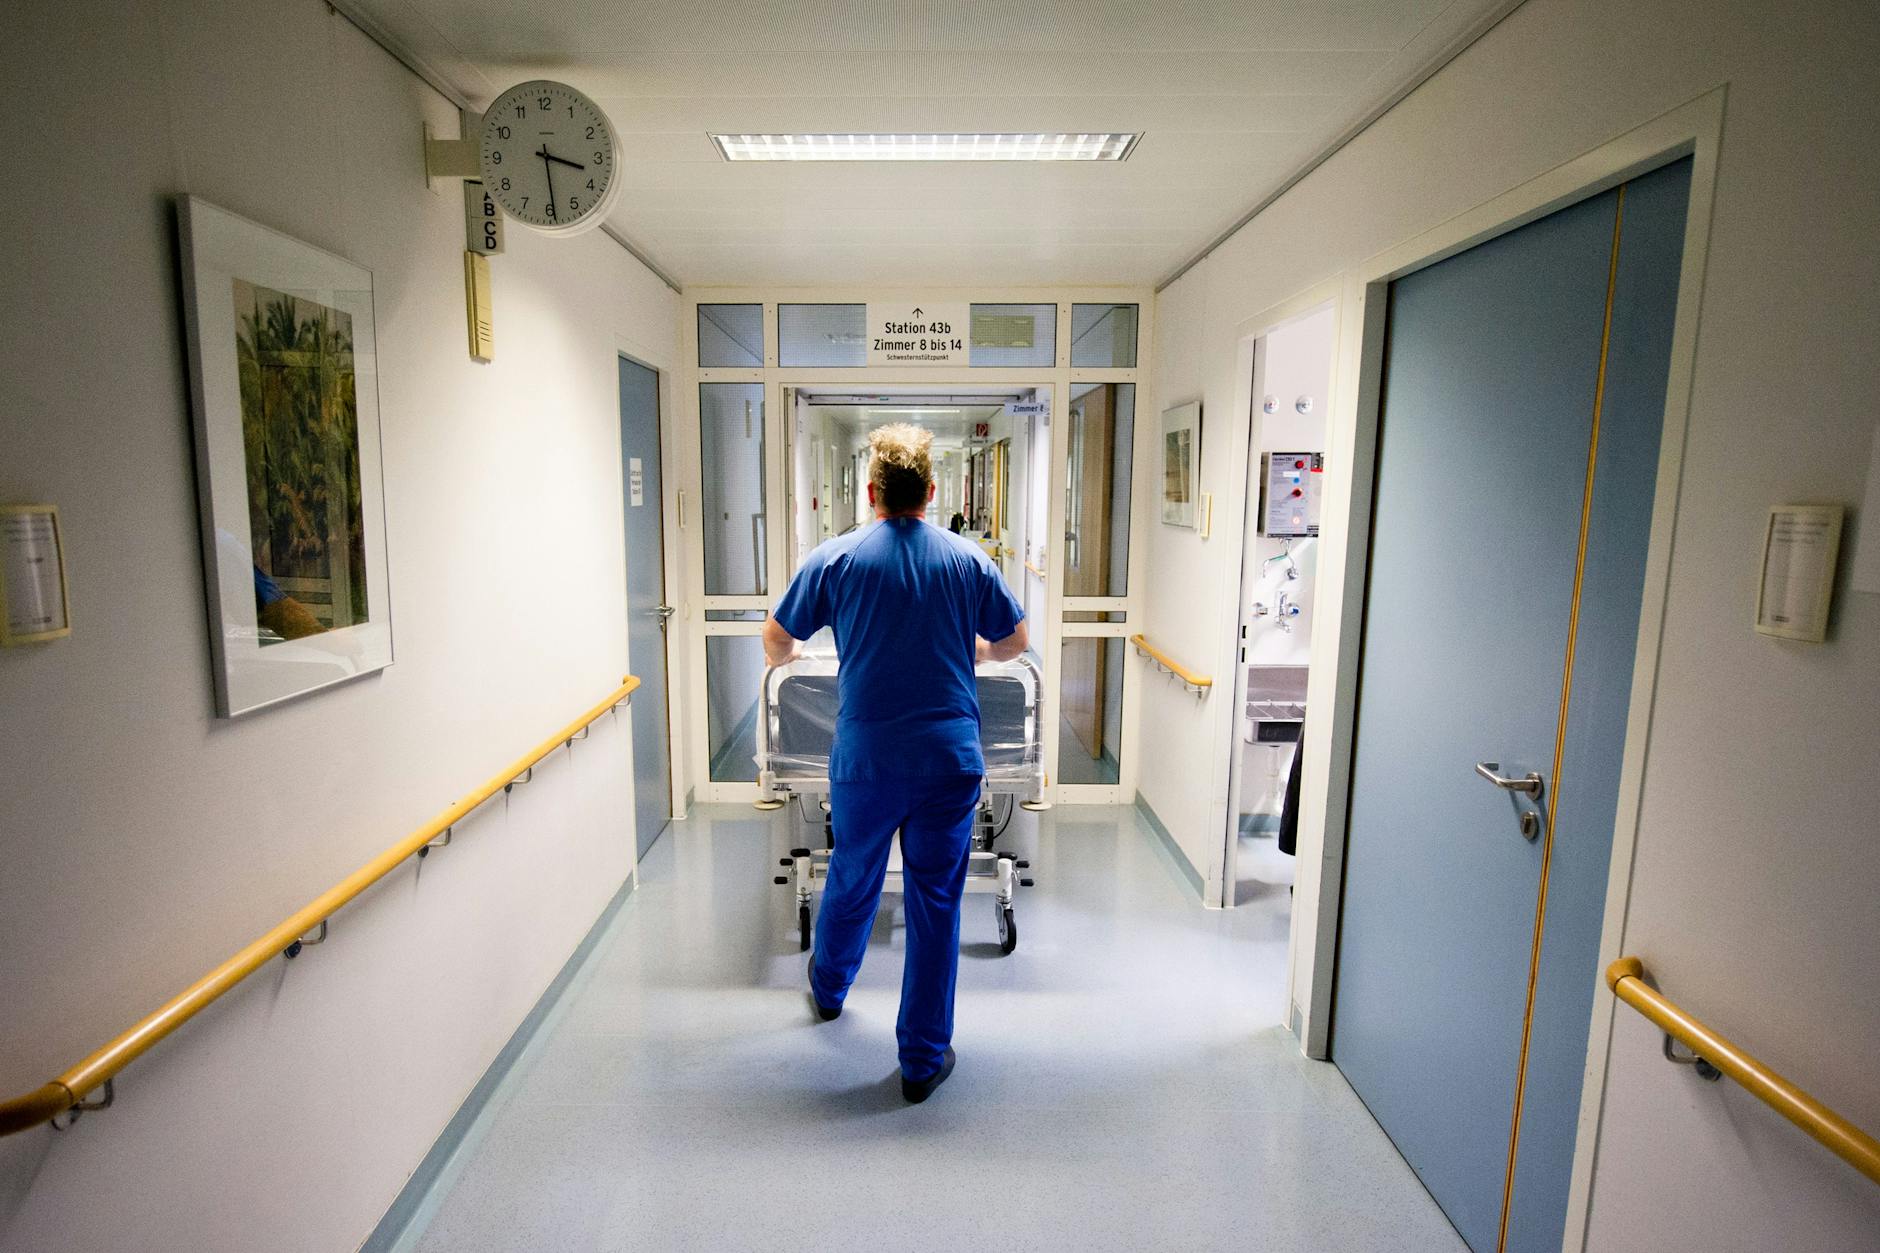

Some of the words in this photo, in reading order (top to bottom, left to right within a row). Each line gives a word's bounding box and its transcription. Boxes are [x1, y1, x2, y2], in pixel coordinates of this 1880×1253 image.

[537, 97, 551, 111] 12
[515, 106, 526, 119] 11
[567, 106, 574, 119] 1
[496, 126, 511, 140] 10
[585, 126, 595, 140] 2
[492, 151, 502, 165] 9
[593, 151, 603, 165] 3
[501, 177, 511, 191] 8
[586, 178, 595, 191] 4
[521, 197, 529, 209] 7
[570, 197, 579, 209] 5
[545, 204, 555, 217] 6
[885, 322, 926, 334] Station
[929, 322, 951, 334] 43b
[873, 339, 916, 351] Zimmer
[919, 339, 927, 351] 8
[930, 339, 947, 351] bis
[950, 339, 962, 351] 14
[1013, 404, 1038, 413] Zimmer
